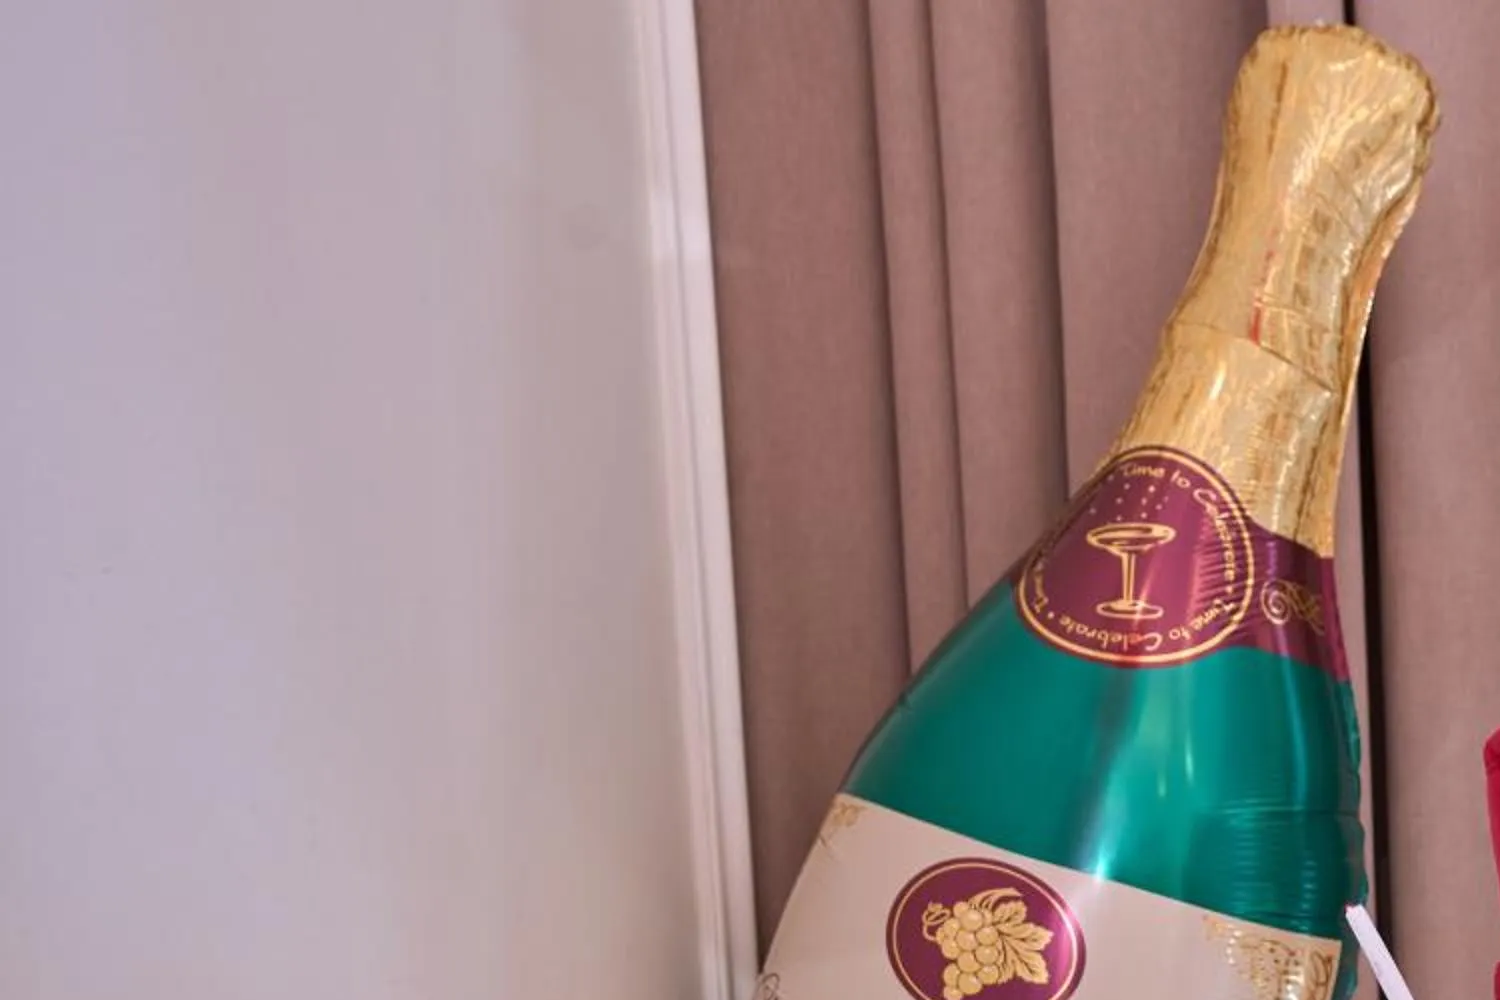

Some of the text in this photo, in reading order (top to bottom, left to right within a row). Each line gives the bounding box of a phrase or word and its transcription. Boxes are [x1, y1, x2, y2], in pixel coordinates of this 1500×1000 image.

[1121, 463, 1166, 479] Time
[1171, 469, 1192, 489] to
[1058, 613, 1163, 652] Celebrate
[1168, 624, 1192, 642] to
